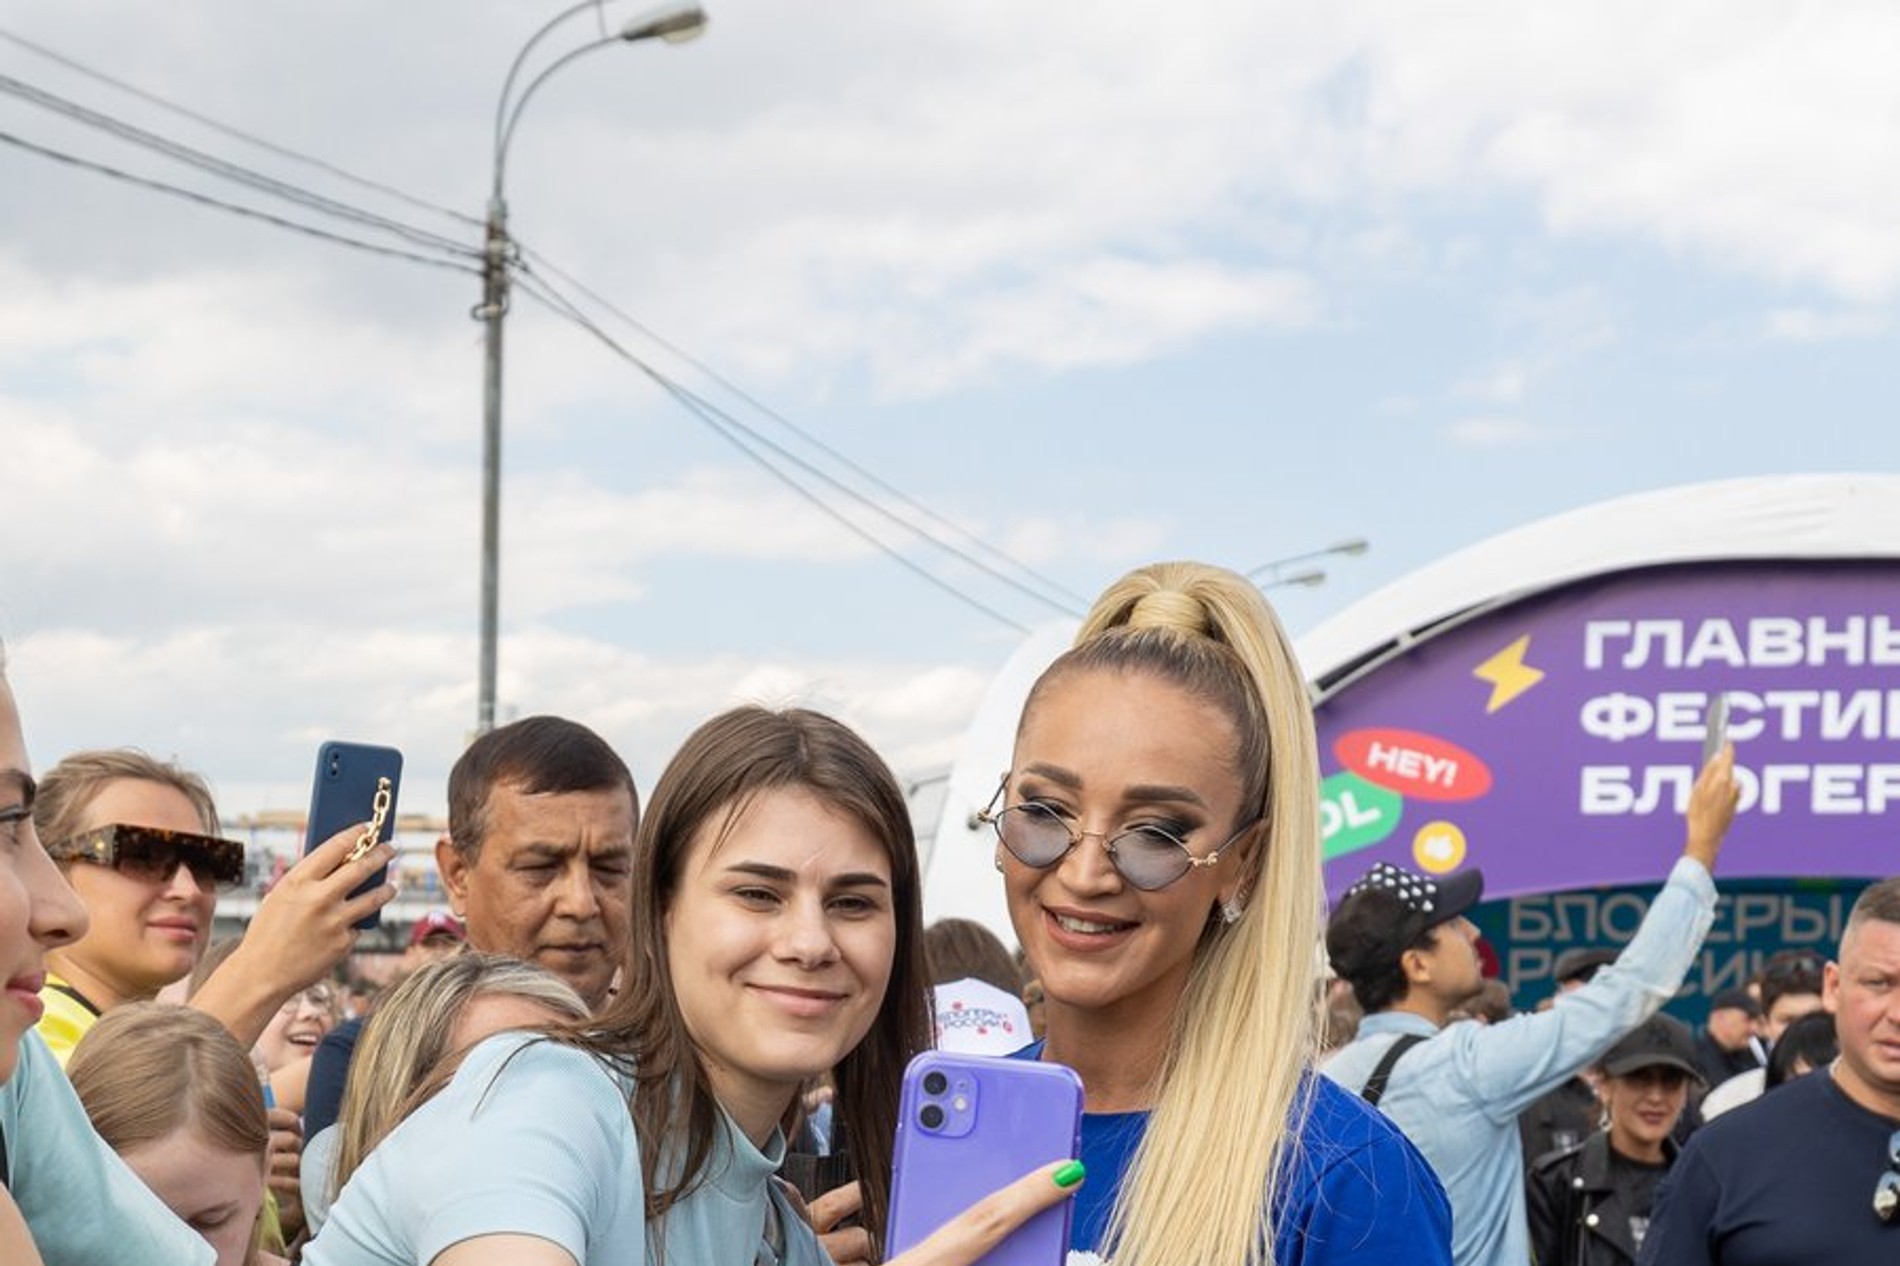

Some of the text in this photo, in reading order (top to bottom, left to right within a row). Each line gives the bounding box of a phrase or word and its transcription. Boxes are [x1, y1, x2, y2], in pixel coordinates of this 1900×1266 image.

[1580, 691, 1900, 741] ФЕСТИ
[1367, 741, 1457, 788] HEY!
[1509, 895, 1842, 941] БЛОЕРЫ
